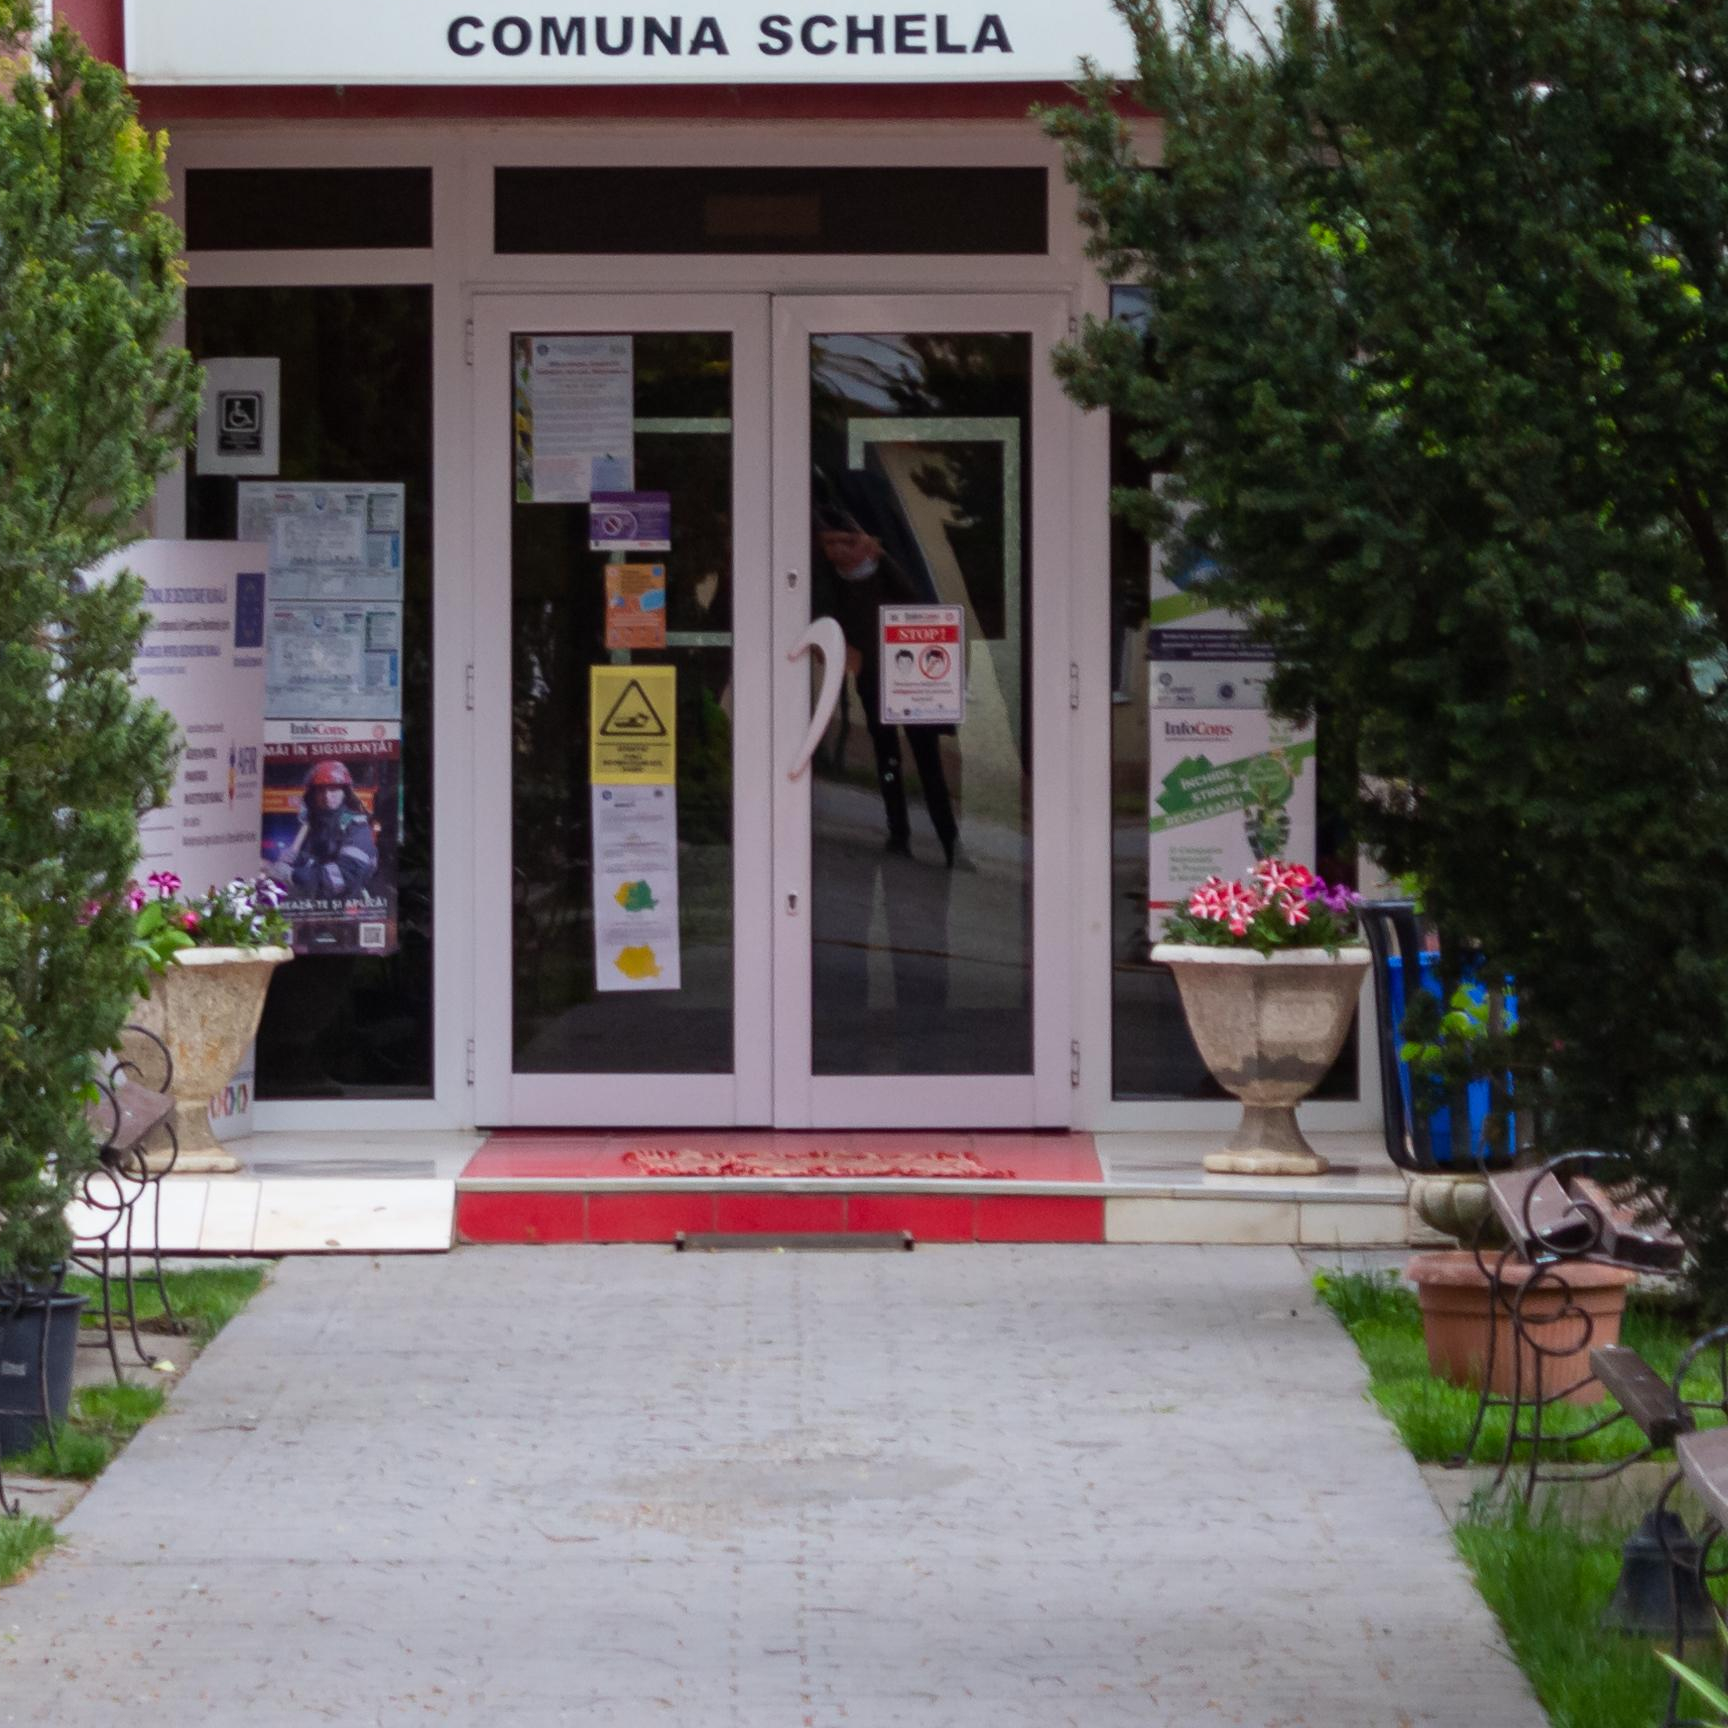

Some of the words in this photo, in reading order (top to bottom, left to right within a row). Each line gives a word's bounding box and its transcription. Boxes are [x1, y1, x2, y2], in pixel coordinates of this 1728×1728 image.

[447, 14, 729, 58] COMUNA
[758, 13, 1012, 56] SCHELA
[1164, 720, 1233, 737] InfoCons
